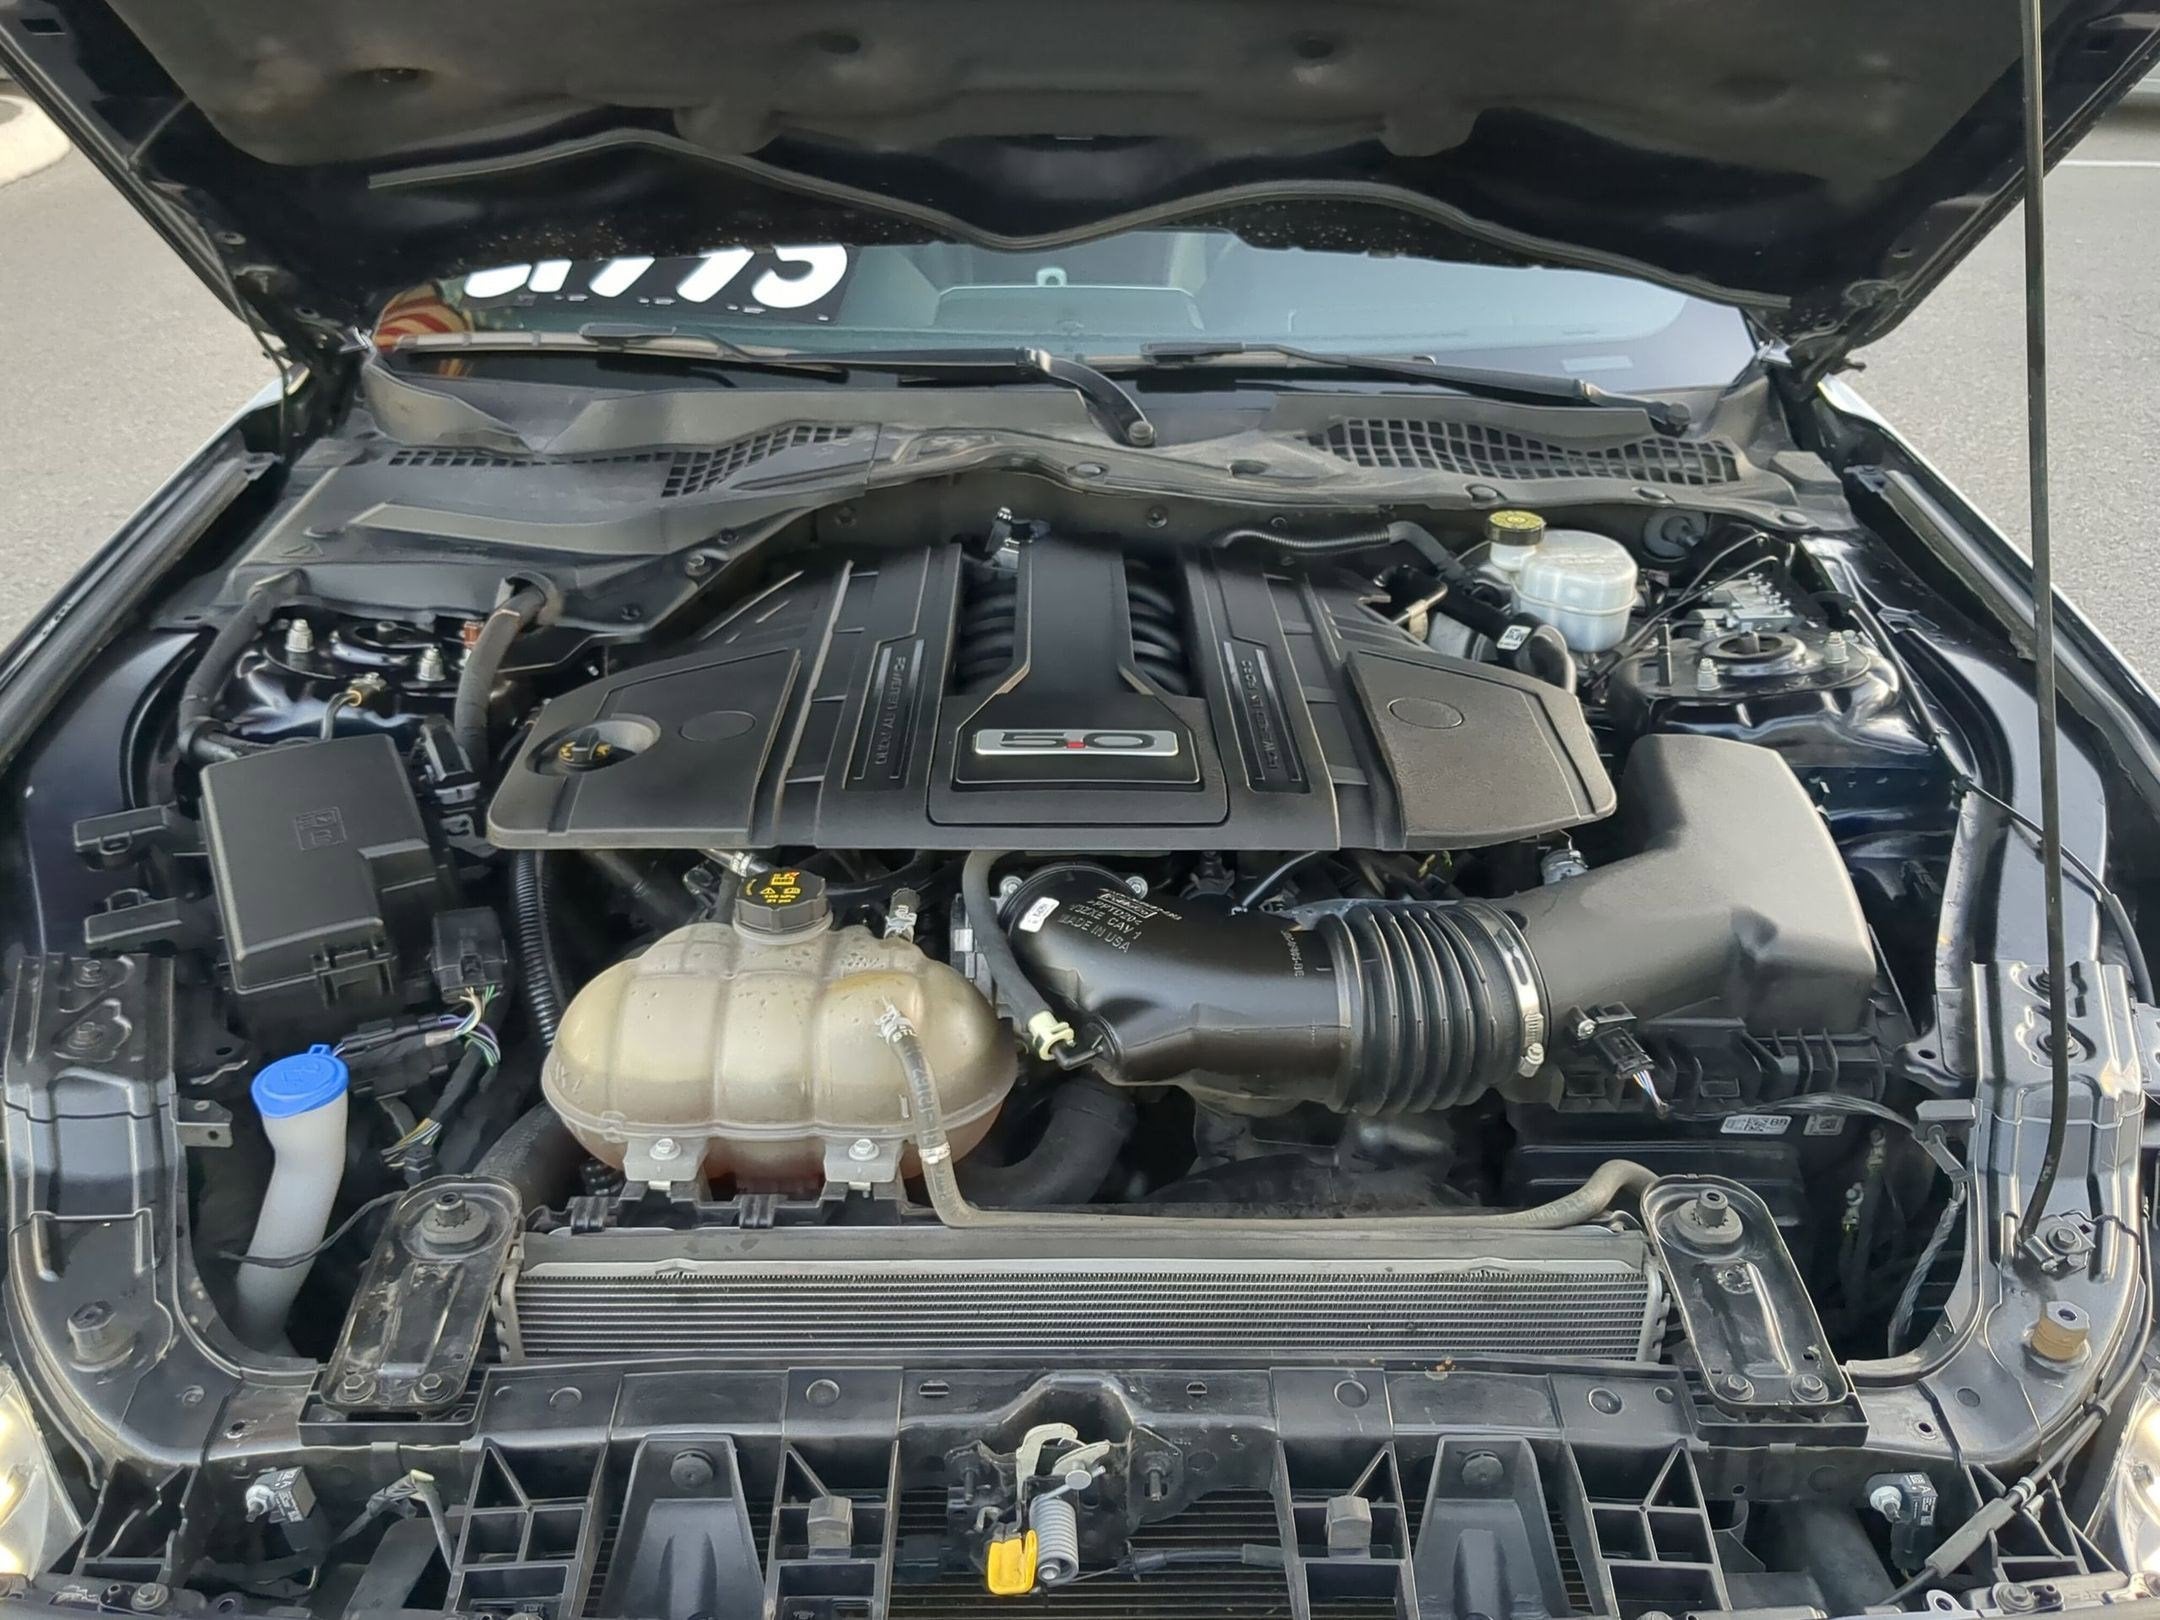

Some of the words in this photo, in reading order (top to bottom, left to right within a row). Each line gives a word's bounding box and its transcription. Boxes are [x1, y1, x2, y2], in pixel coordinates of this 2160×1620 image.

[1000, 731, 1156, 750] 5.0
[1057, 914, 1094, 931] MADE
[1091, 924, 1106, 938] IN
[1104, 932, 1131, 953] USA
[1107, 917, 1135, 934] CAV
